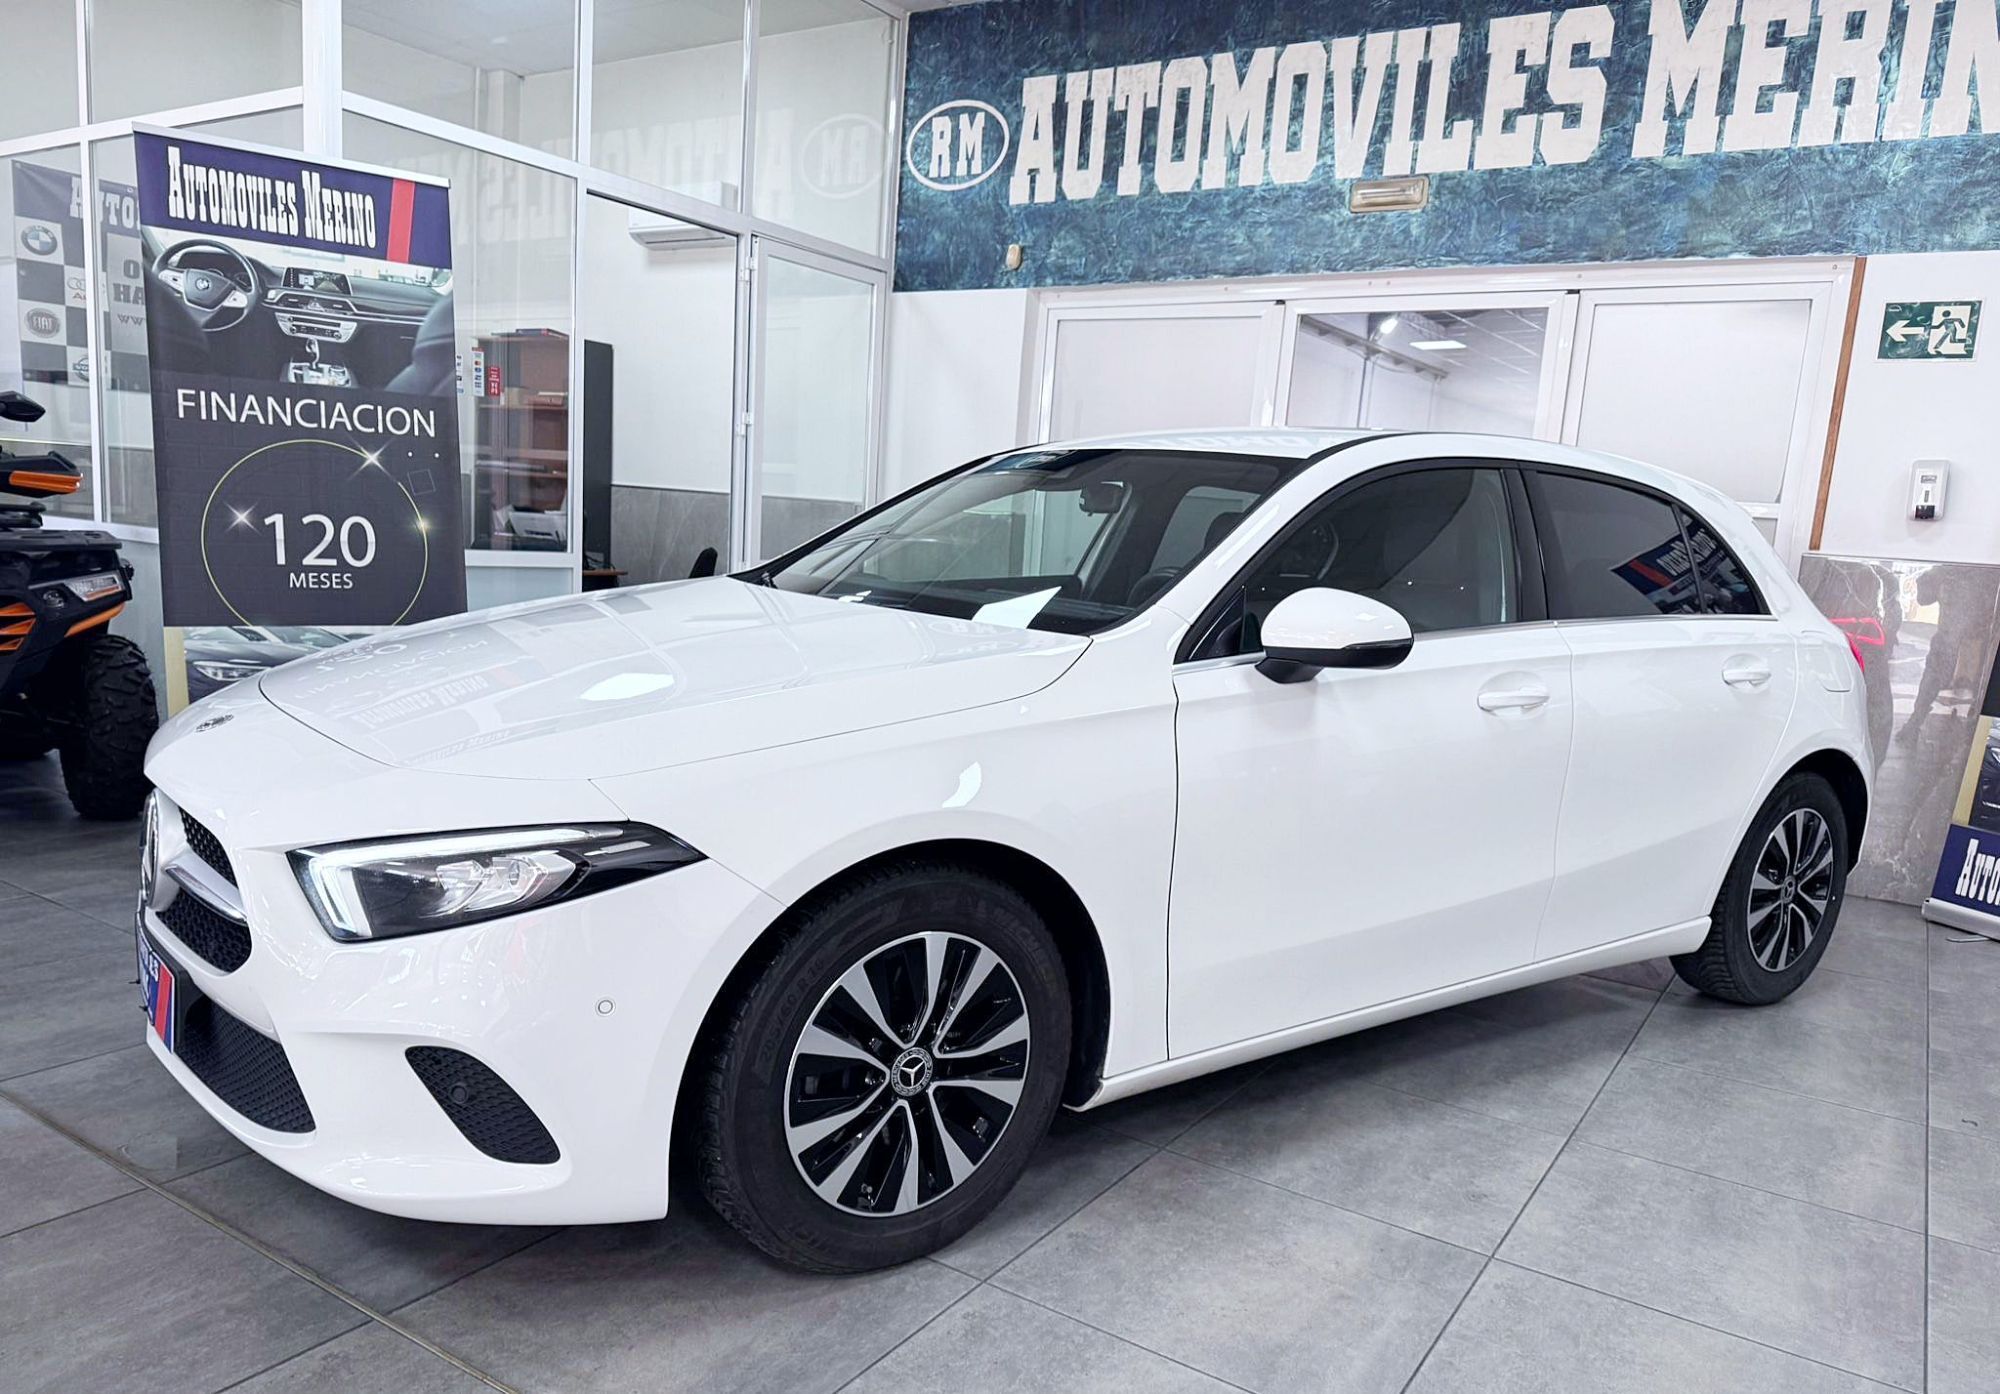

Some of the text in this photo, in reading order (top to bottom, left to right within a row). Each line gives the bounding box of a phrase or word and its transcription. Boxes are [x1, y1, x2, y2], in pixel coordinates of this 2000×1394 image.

[1009, 6, 1614, 206] AUTOMOVILES
[929, 112, 986, 178] RM
[166, 146, 377, 249] AUTOMOVILES MERINO
[177, 388, 437, 438] FINANCIACION
[264, 513, 376, 568] 120
[289, 571, 353, 590] MESES
